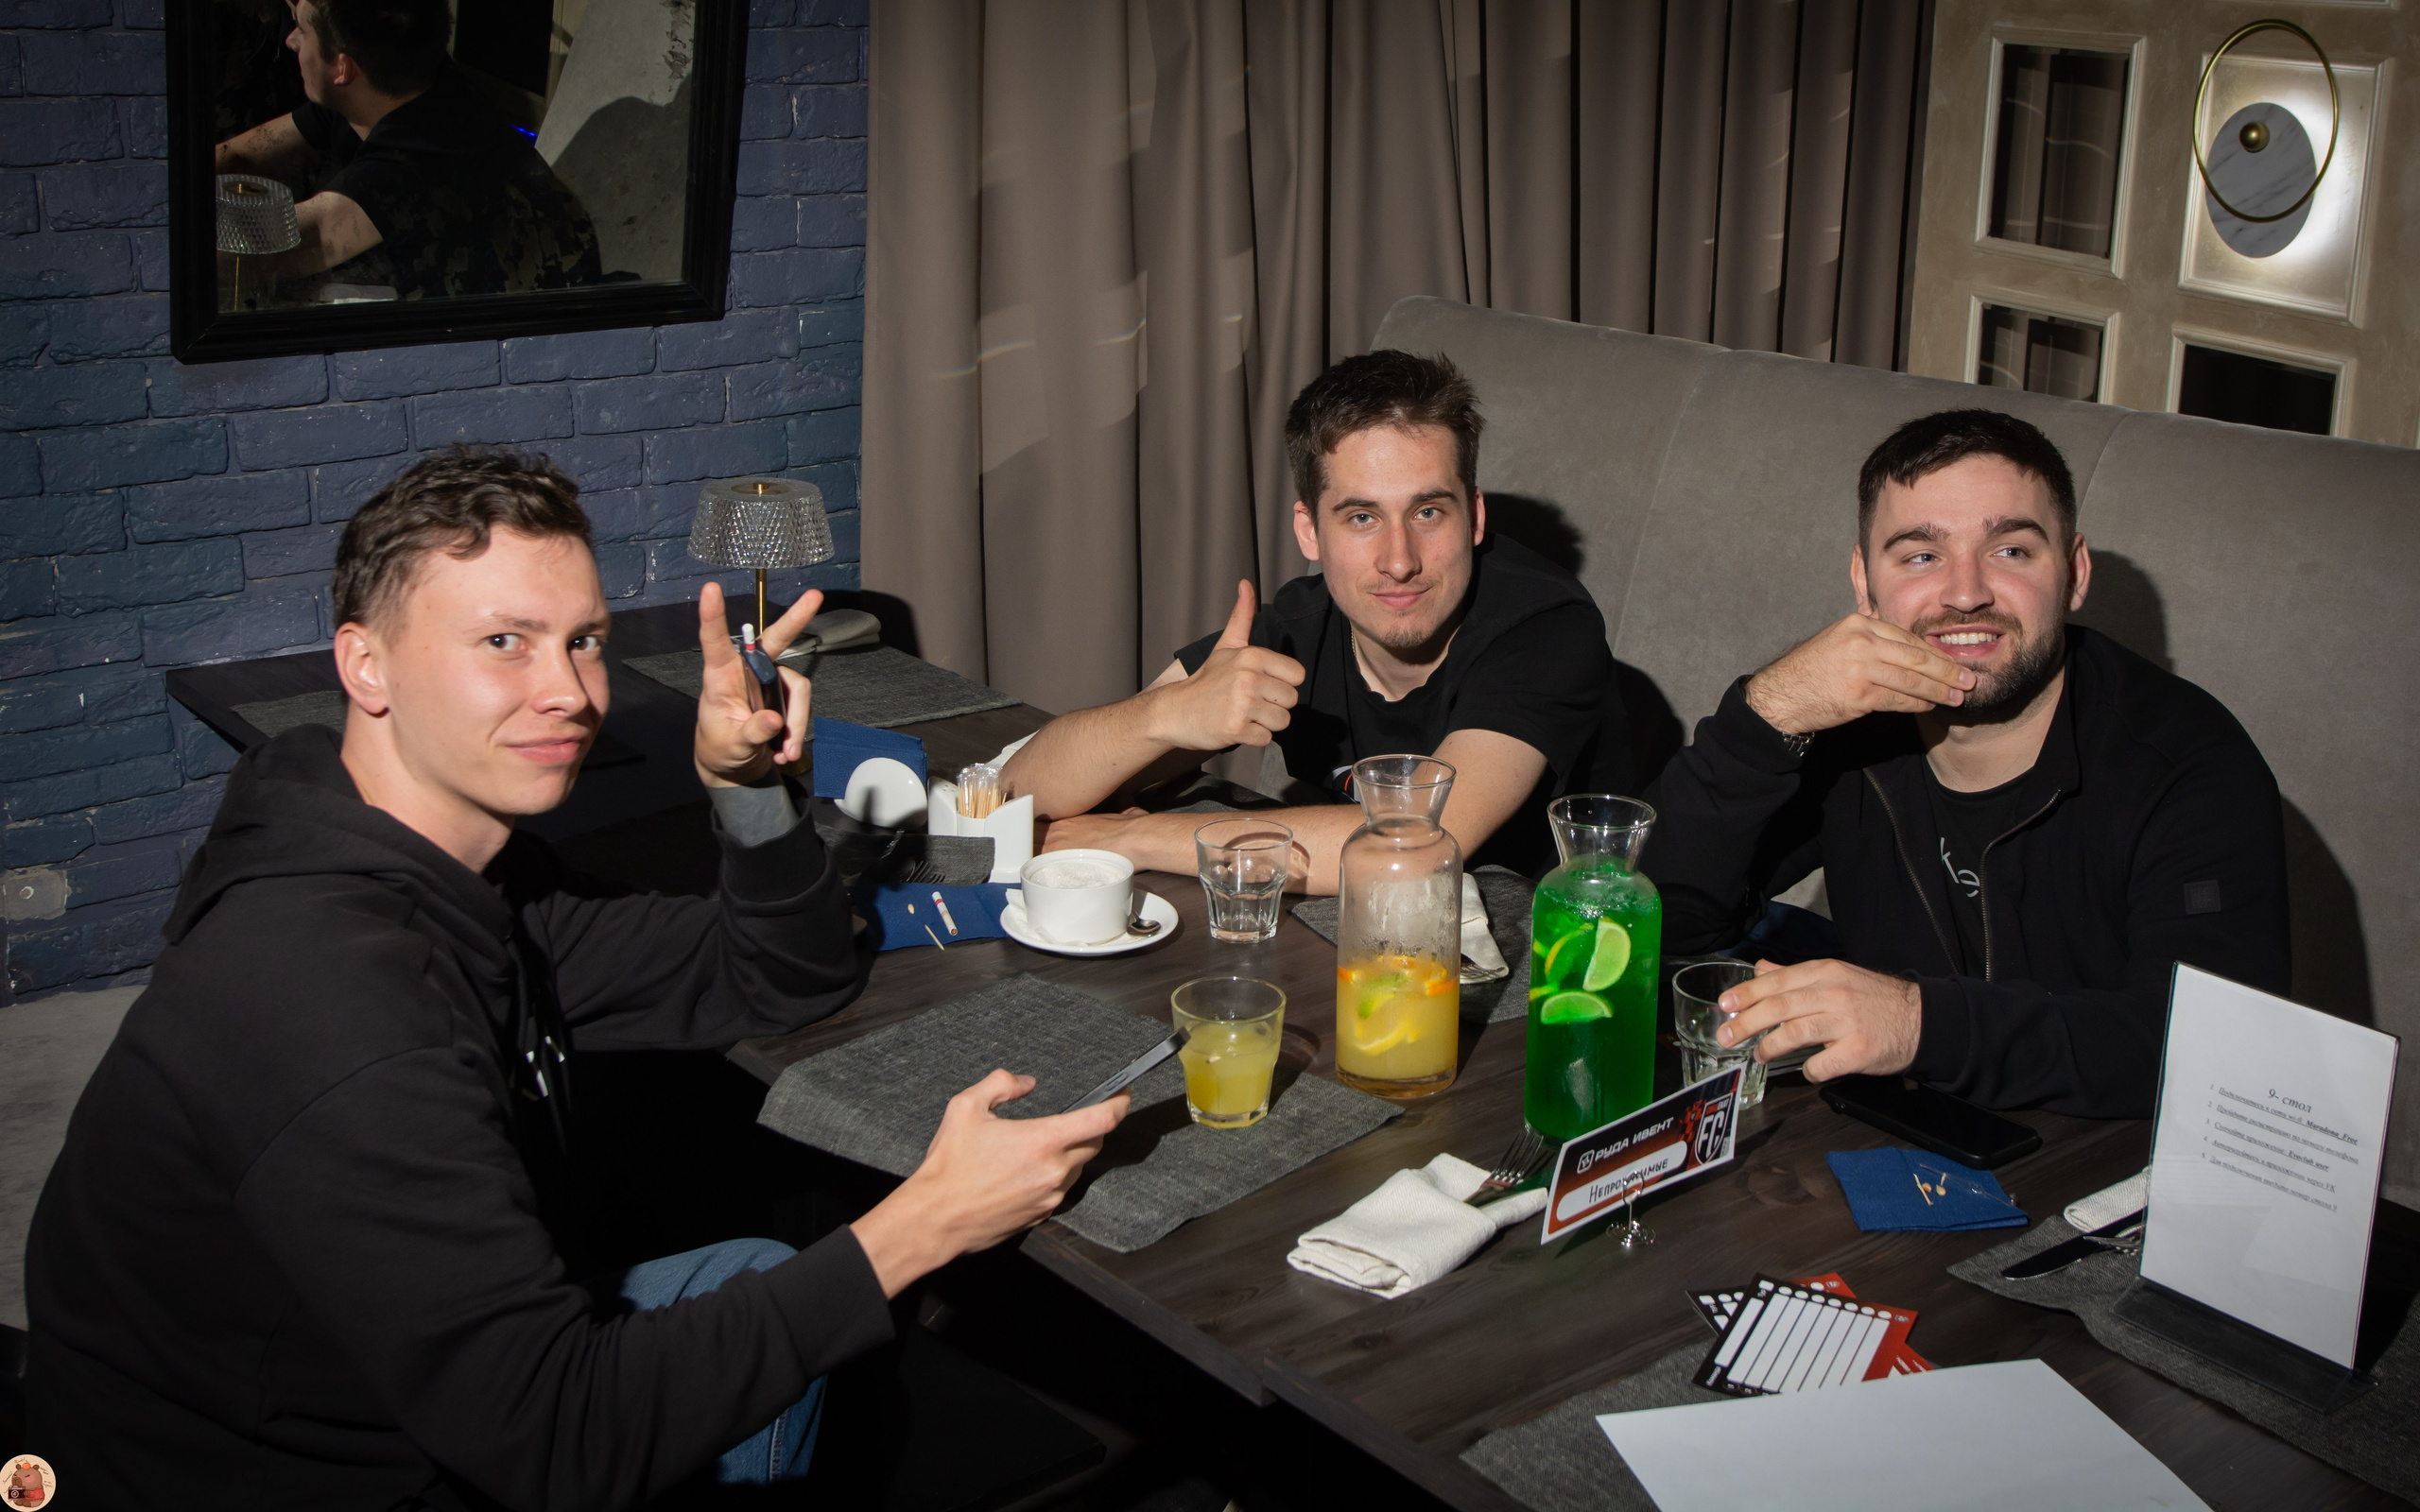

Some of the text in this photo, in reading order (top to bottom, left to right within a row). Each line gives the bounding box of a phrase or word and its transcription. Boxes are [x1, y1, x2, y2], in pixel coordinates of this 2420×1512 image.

[2281, 1096, 2312, 1113] стол
[1595, 1117, 1674, 1162] РУДА ИВЕНТ
[1698, 1110, 1725, 1159] FC
